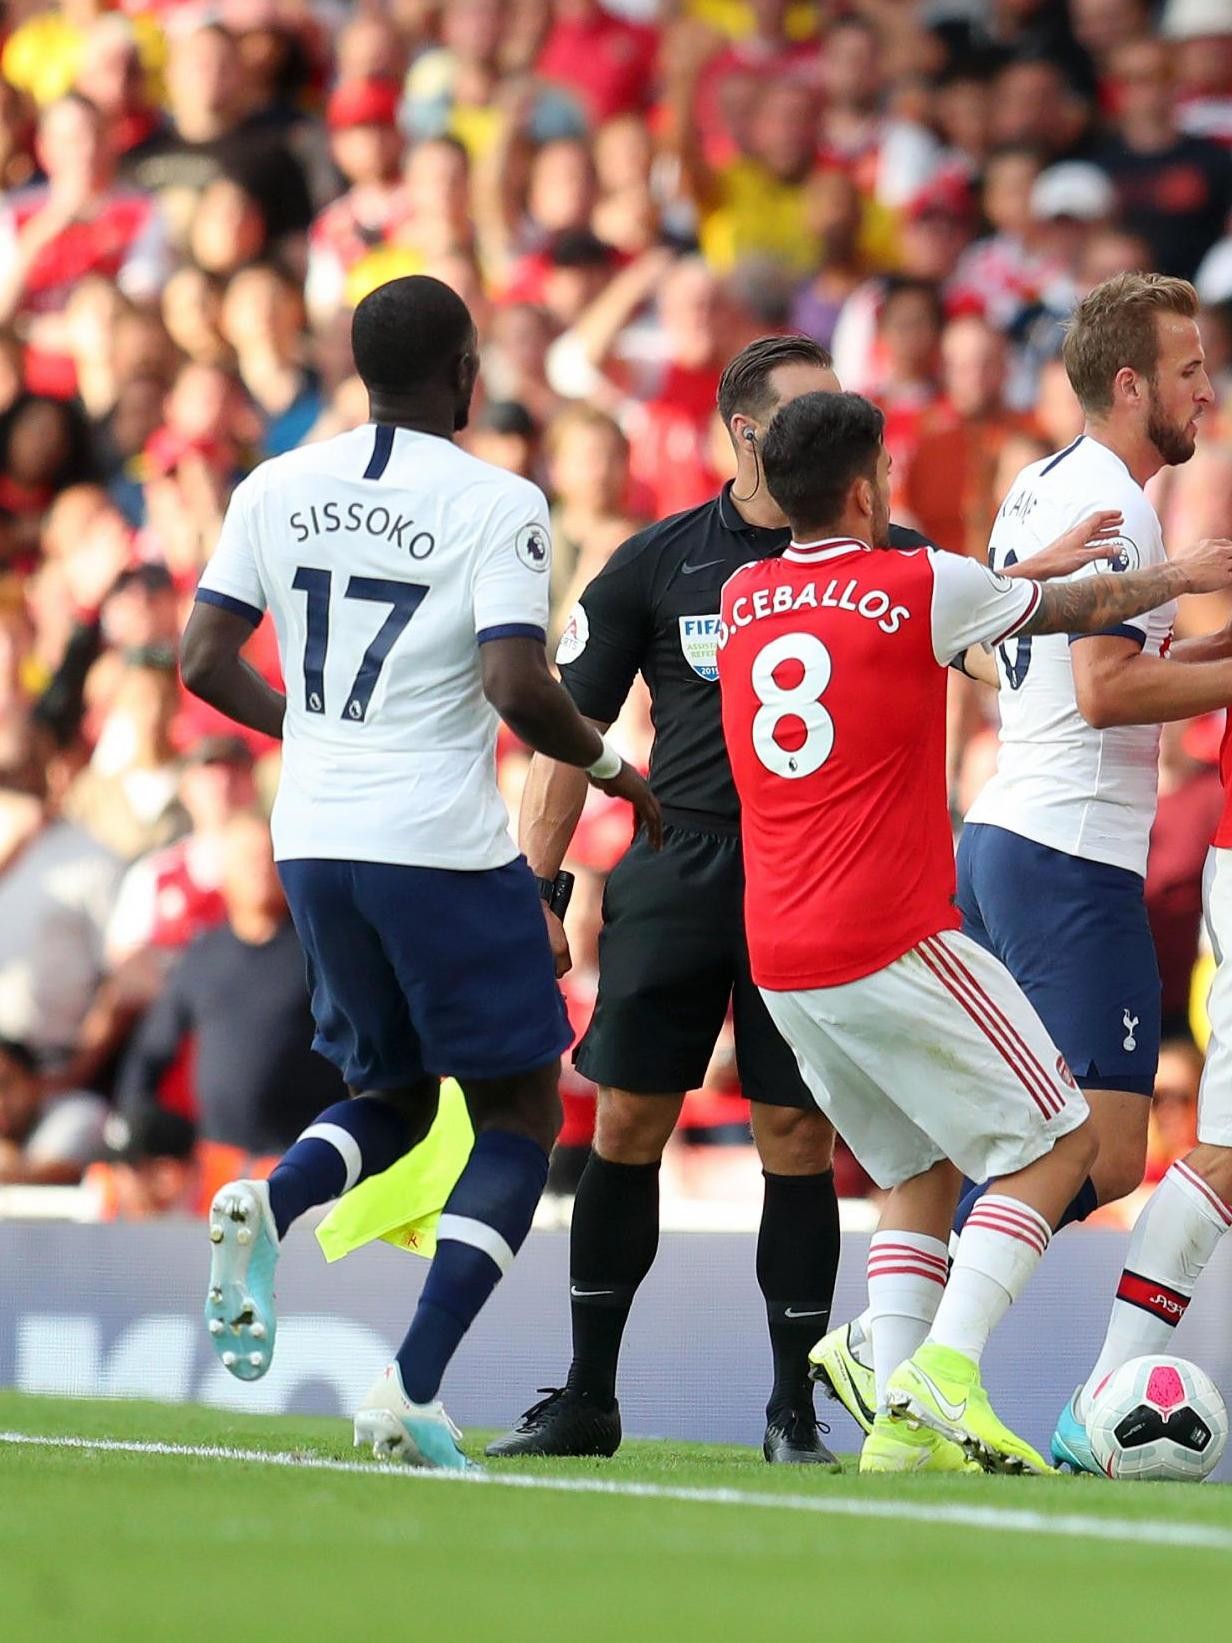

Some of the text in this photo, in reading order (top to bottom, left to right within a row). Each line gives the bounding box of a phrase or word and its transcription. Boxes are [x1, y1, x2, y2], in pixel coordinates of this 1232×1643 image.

[290, 502, 435, 560] SISSOKO
[291, 566, 431, 722] 17
[752, 631, 835, 780] 8
